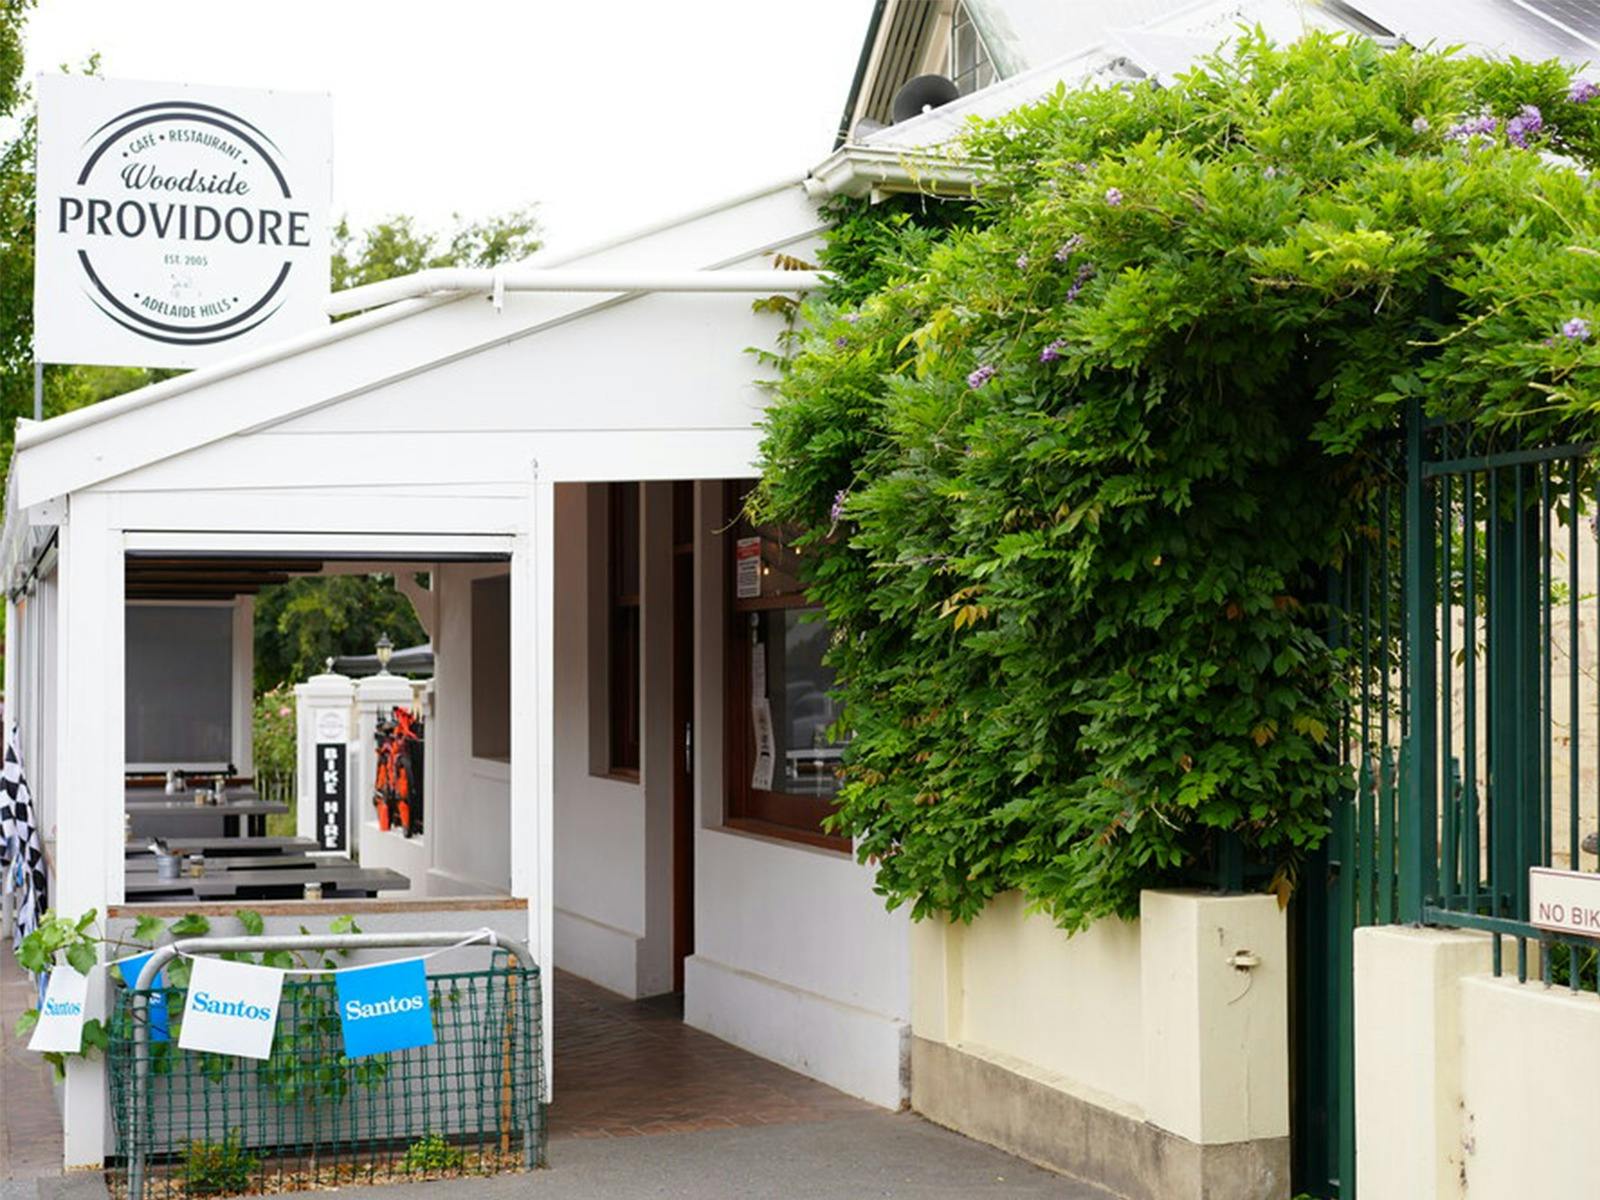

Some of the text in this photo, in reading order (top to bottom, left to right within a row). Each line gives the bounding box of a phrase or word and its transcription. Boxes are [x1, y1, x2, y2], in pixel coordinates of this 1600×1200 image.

[169, 129, 242, 160] RESTAURANT
[121, 162, 250, 196] Woodside
[58, 196, 311, 247] PROVIDORE
[184, 255, 208, 267] 2005
[141, 295, 231, 318] ADELAIDE HILLS
[323, 747, 338, 848] BIKE HIRE
[1539, 902, 1600, 927] NO BIK
[45, 997, 81, 1017] Santos
[192, 991, 271, 1022] Santos
[345, 992, 424, 1022] Santos
